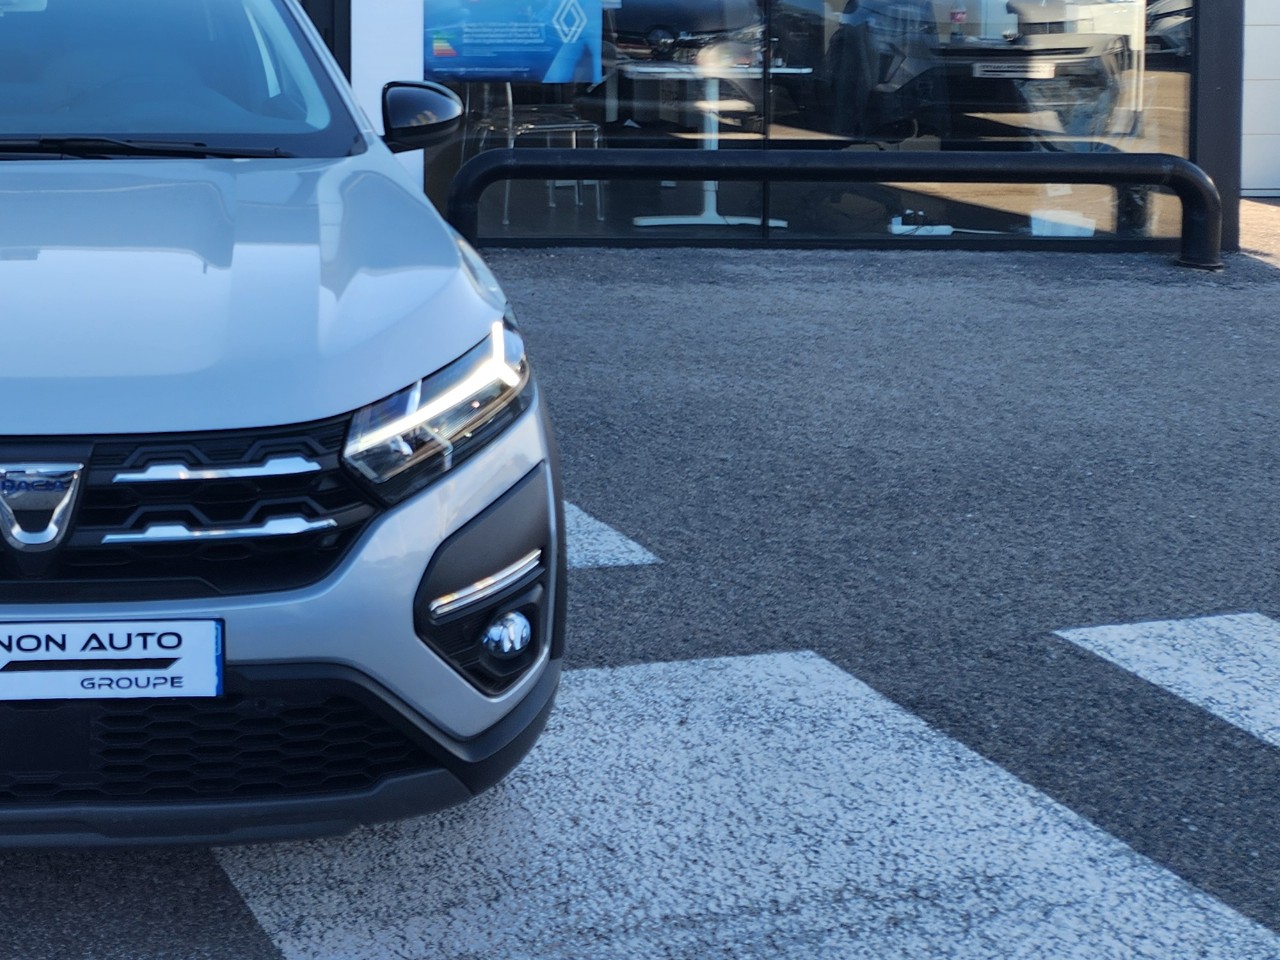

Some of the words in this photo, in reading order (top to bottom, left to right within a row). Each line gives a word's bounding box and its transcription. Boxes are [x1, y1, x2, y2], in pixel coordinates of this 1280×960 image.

[1, 480, 65, 492] DACIA
[80, 631, 184, 653] AUTO
[80, 675, 185, 691] GROUPE
